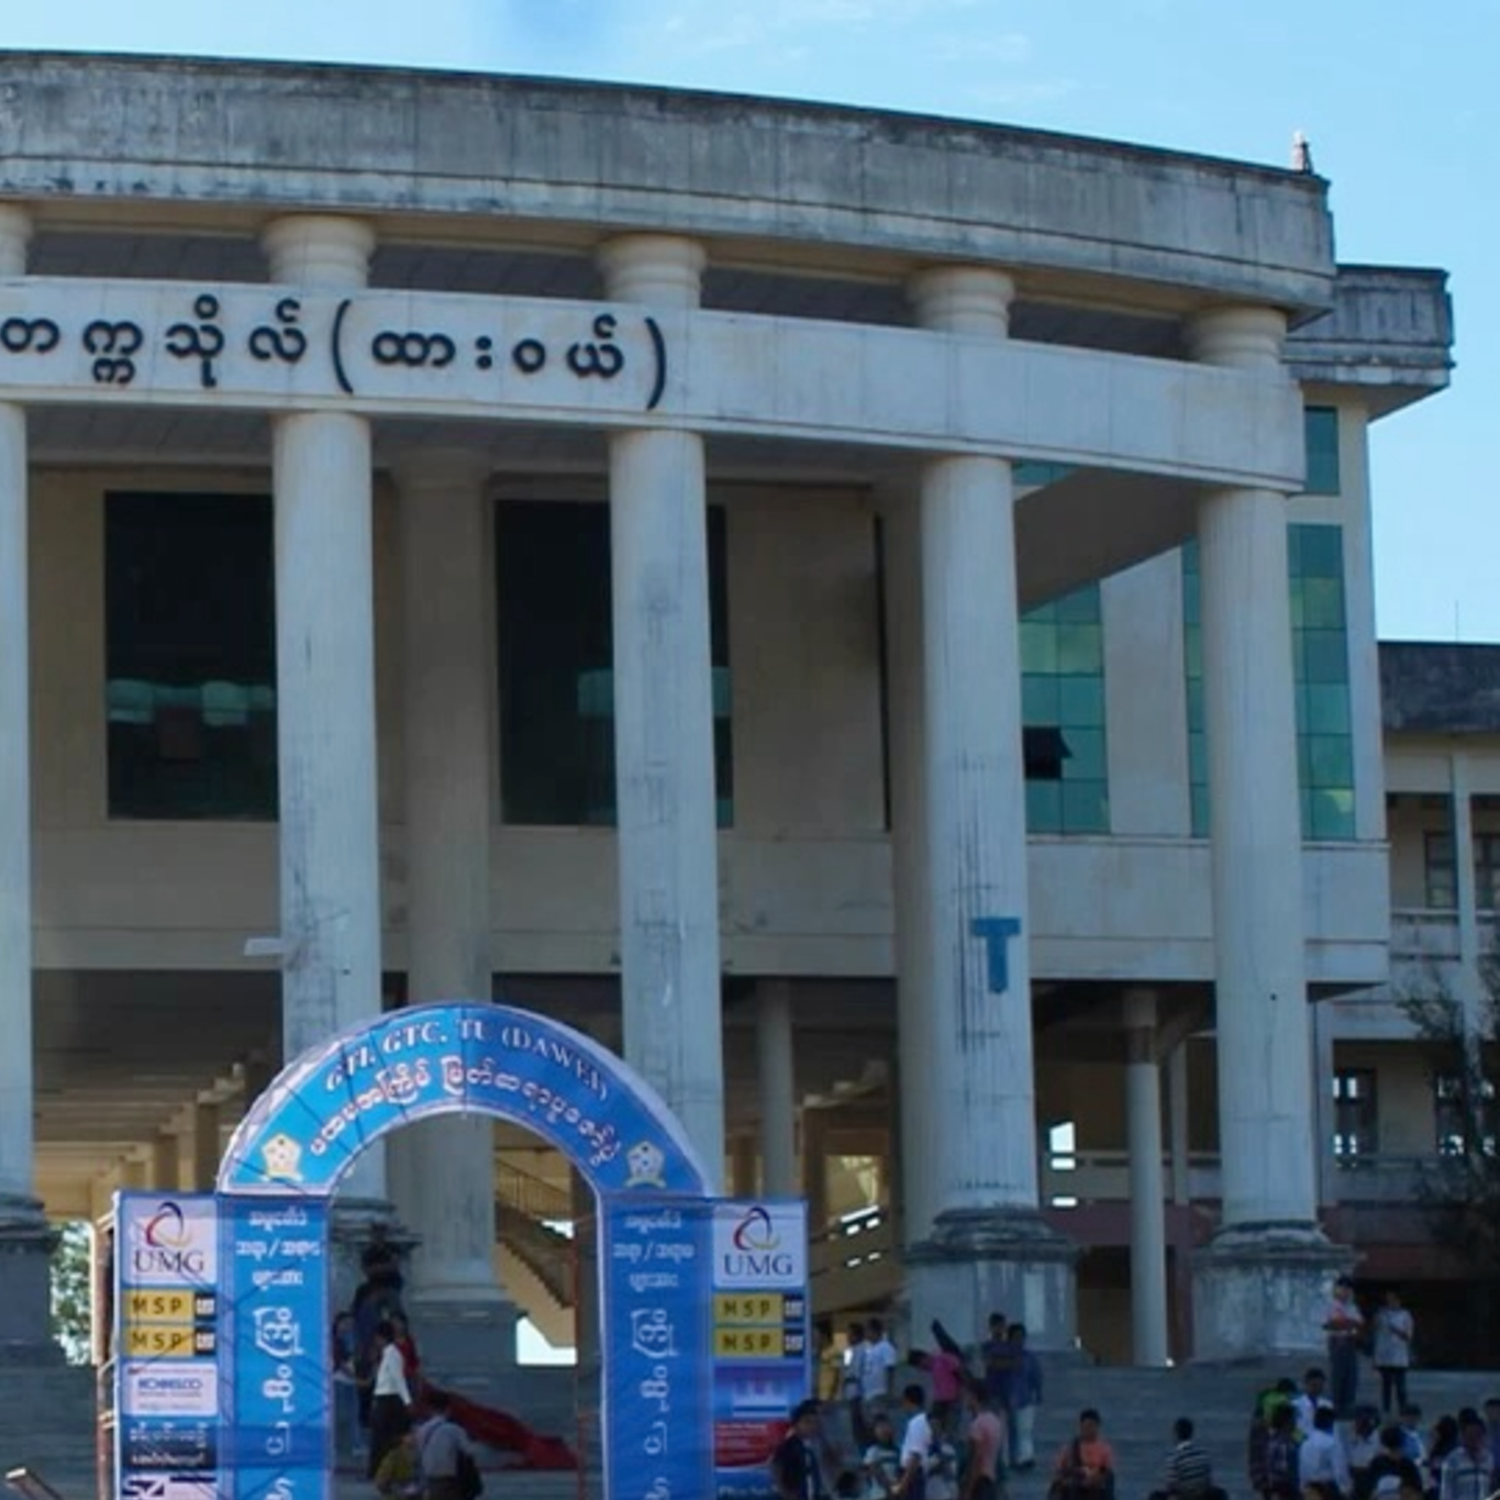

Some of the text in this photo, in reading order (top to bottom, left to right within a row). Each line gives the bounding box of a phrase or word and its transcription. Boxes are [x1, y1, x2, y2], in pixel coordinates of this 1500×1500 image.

[502, 1026, 608, 1100] (DAWEI)
[134, 1250, 204, 1273] UMG
[723, 1254, 793, 1277] UMG
